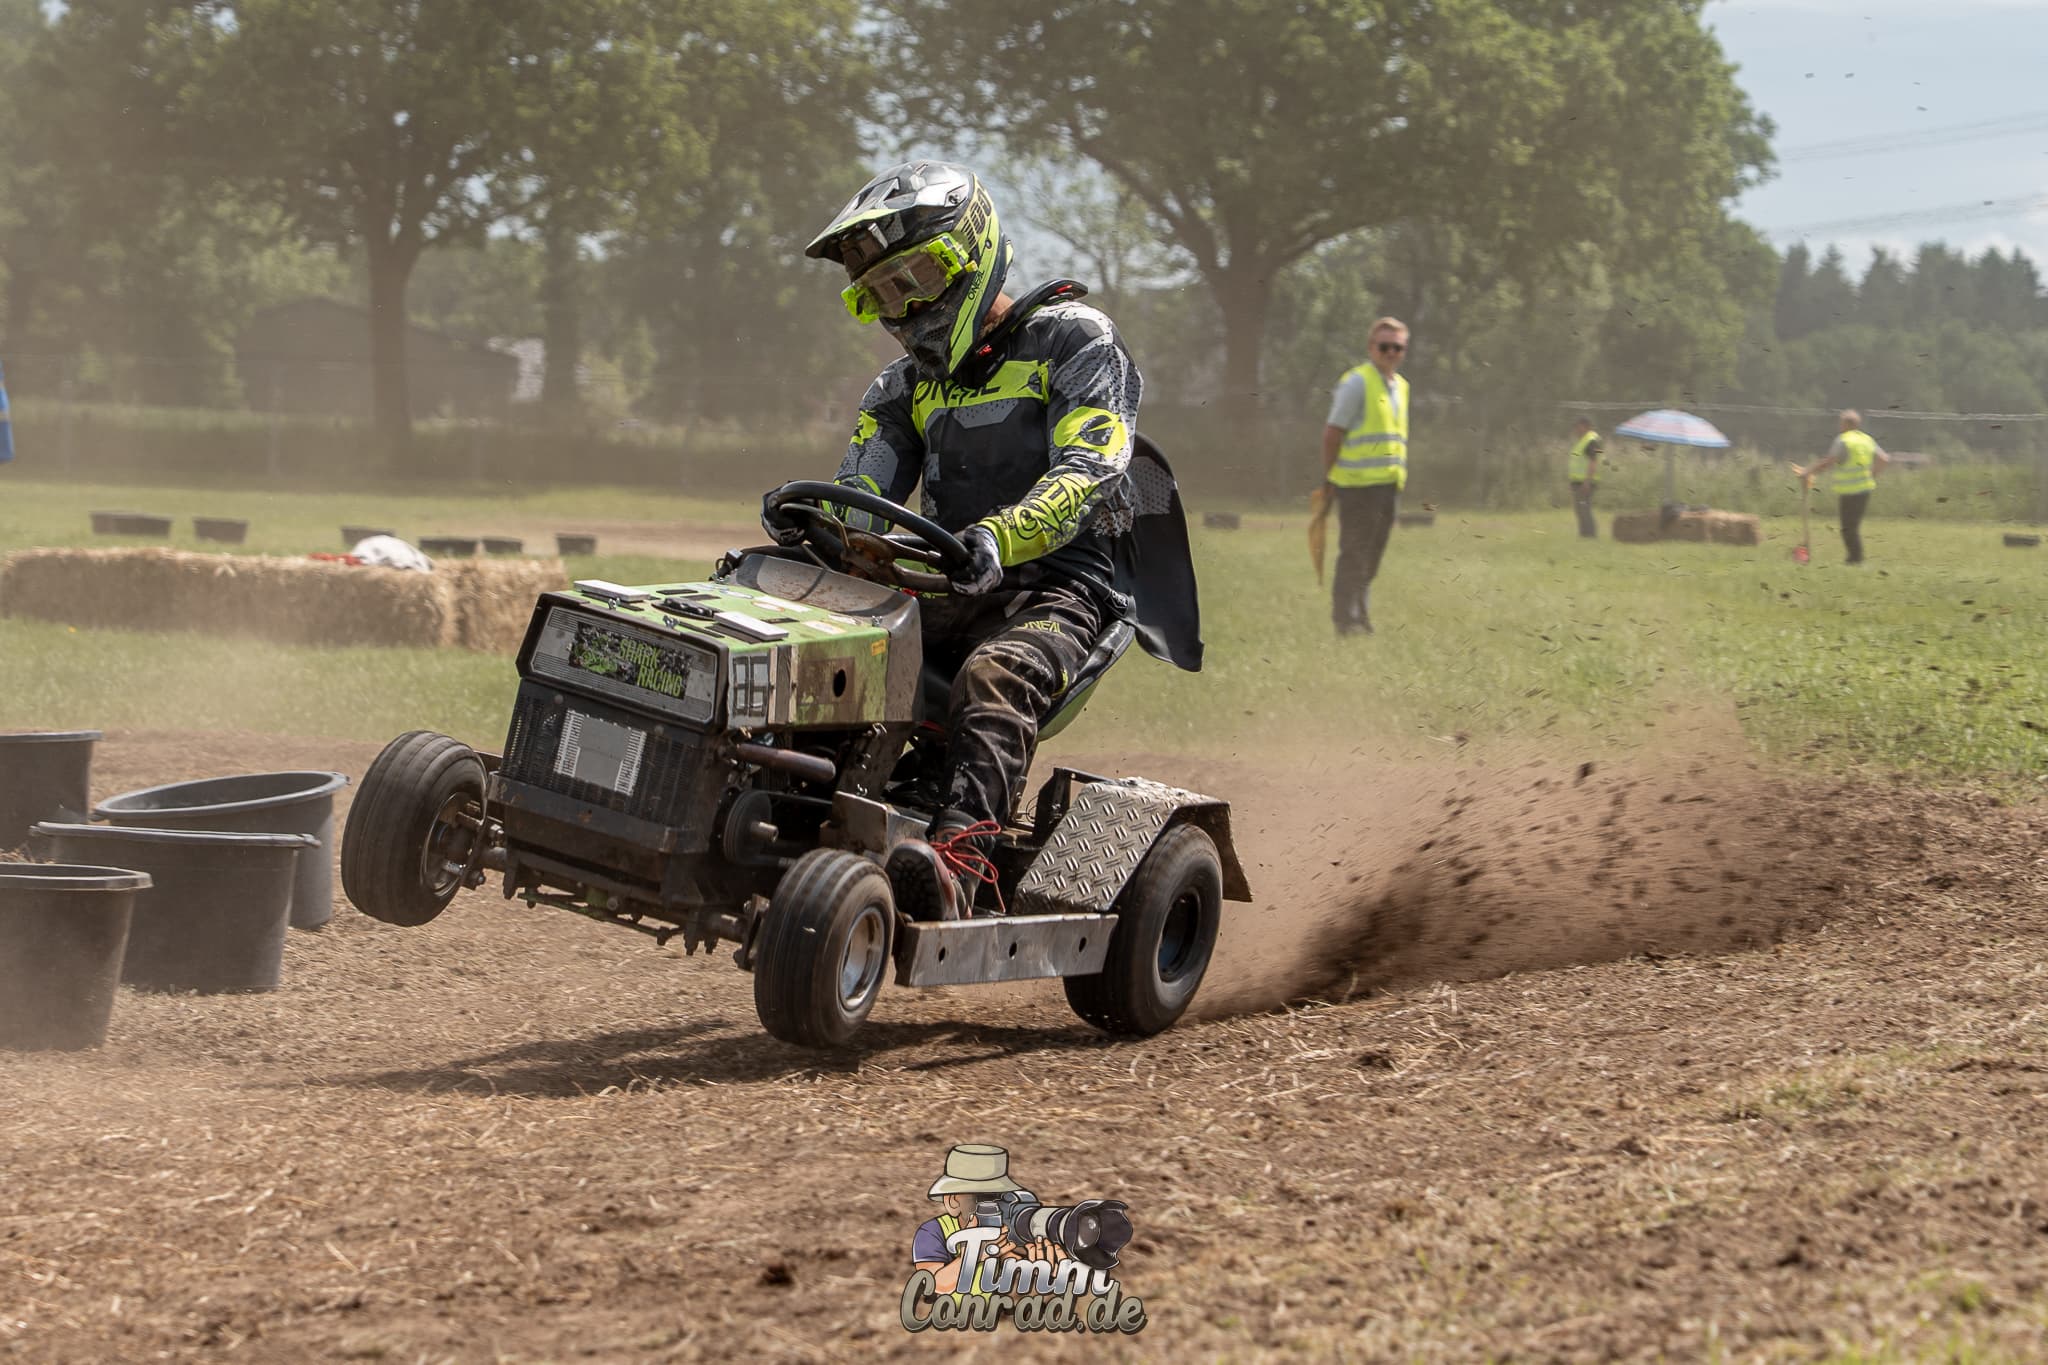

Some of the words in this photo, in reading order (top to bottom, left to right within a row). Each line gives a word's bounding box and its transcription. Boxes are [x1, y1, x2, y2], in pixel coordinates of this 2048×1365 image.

[1013, 472, 1100, 540] ONEAL
[619, 638, 661, 669] SHARK
[637, 665, 683, 697] RACING
